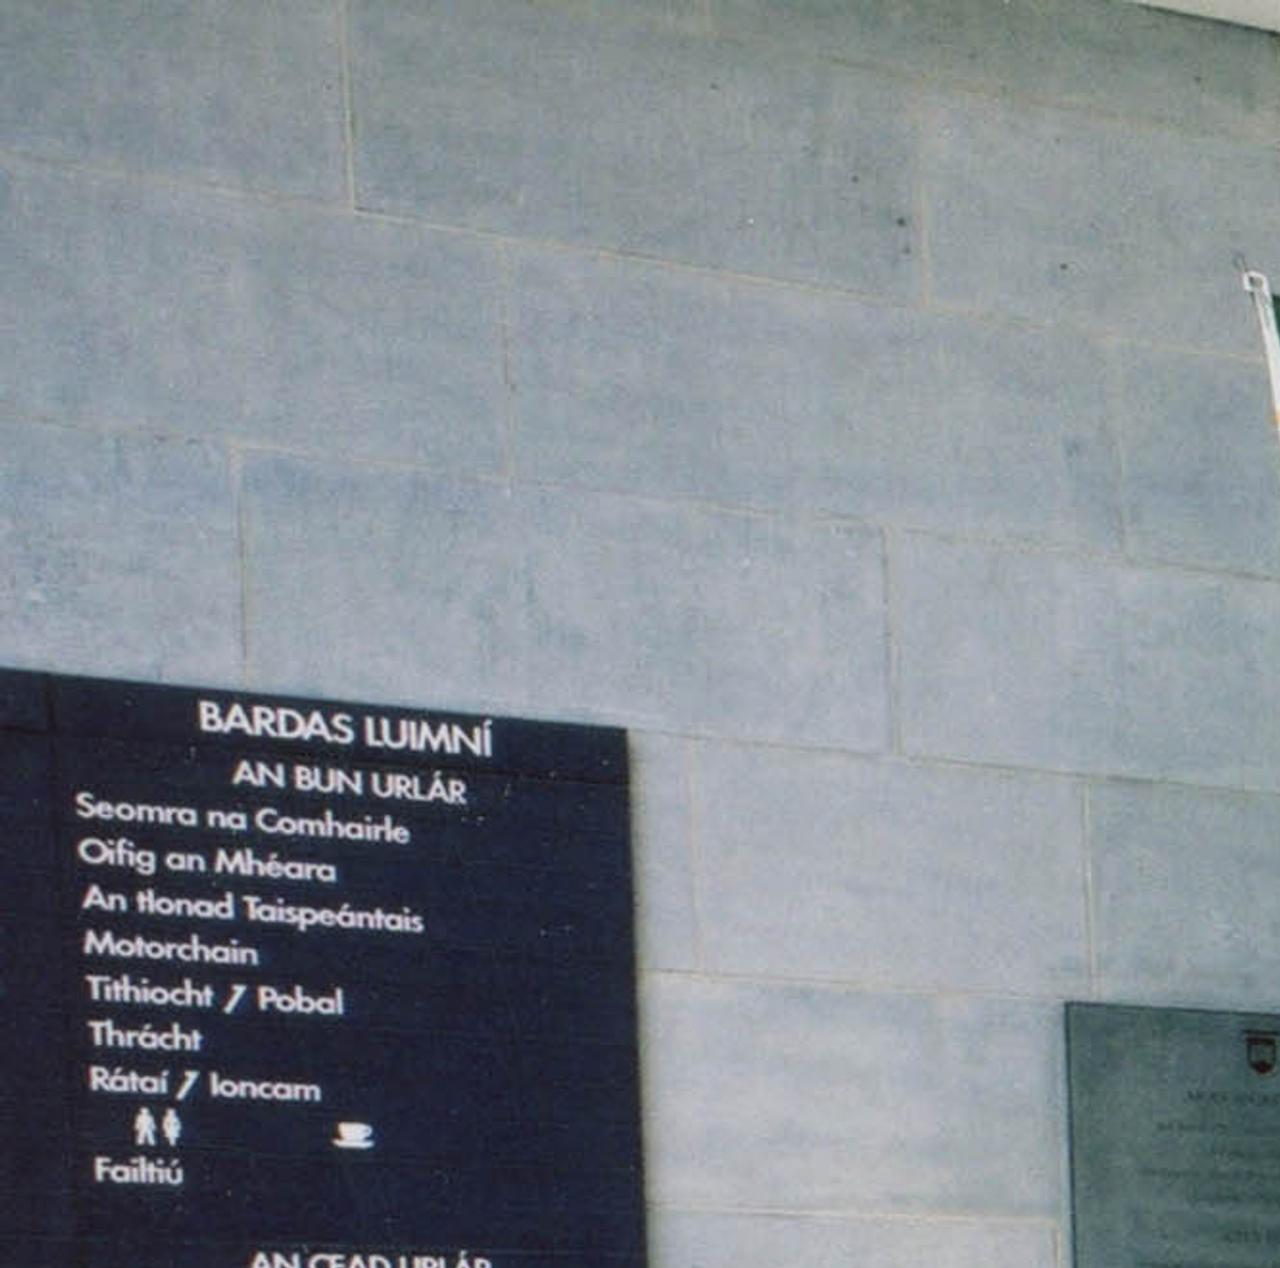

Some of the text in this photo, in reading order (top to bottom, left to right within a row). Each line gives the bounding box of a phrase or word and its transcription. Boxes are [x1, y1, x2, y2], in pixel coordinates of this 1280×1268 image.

[199, 698, 493, 757] BARDAS LUIMNÍ
[233, 760, 467, 805] AN BUN URLÁR
[76, 792, 410, 844] Seomra na Comhairle
[77, 837, 337, 882] Oifig an Mhéara
[82, 884, 128, 911] An
[242, 895, 424, 933] Taispeántais
[83, 929, 259, 965] Motorchain
[86, 974, 214, 1007] Tithiocht
[258, 985, 344, 1015] Pobal
[88, 1019, 203, 1051] Thrácht
[89, 1065, 169, 1094] Rátaí
[210, 1071, 321, 1102] Ioncam
